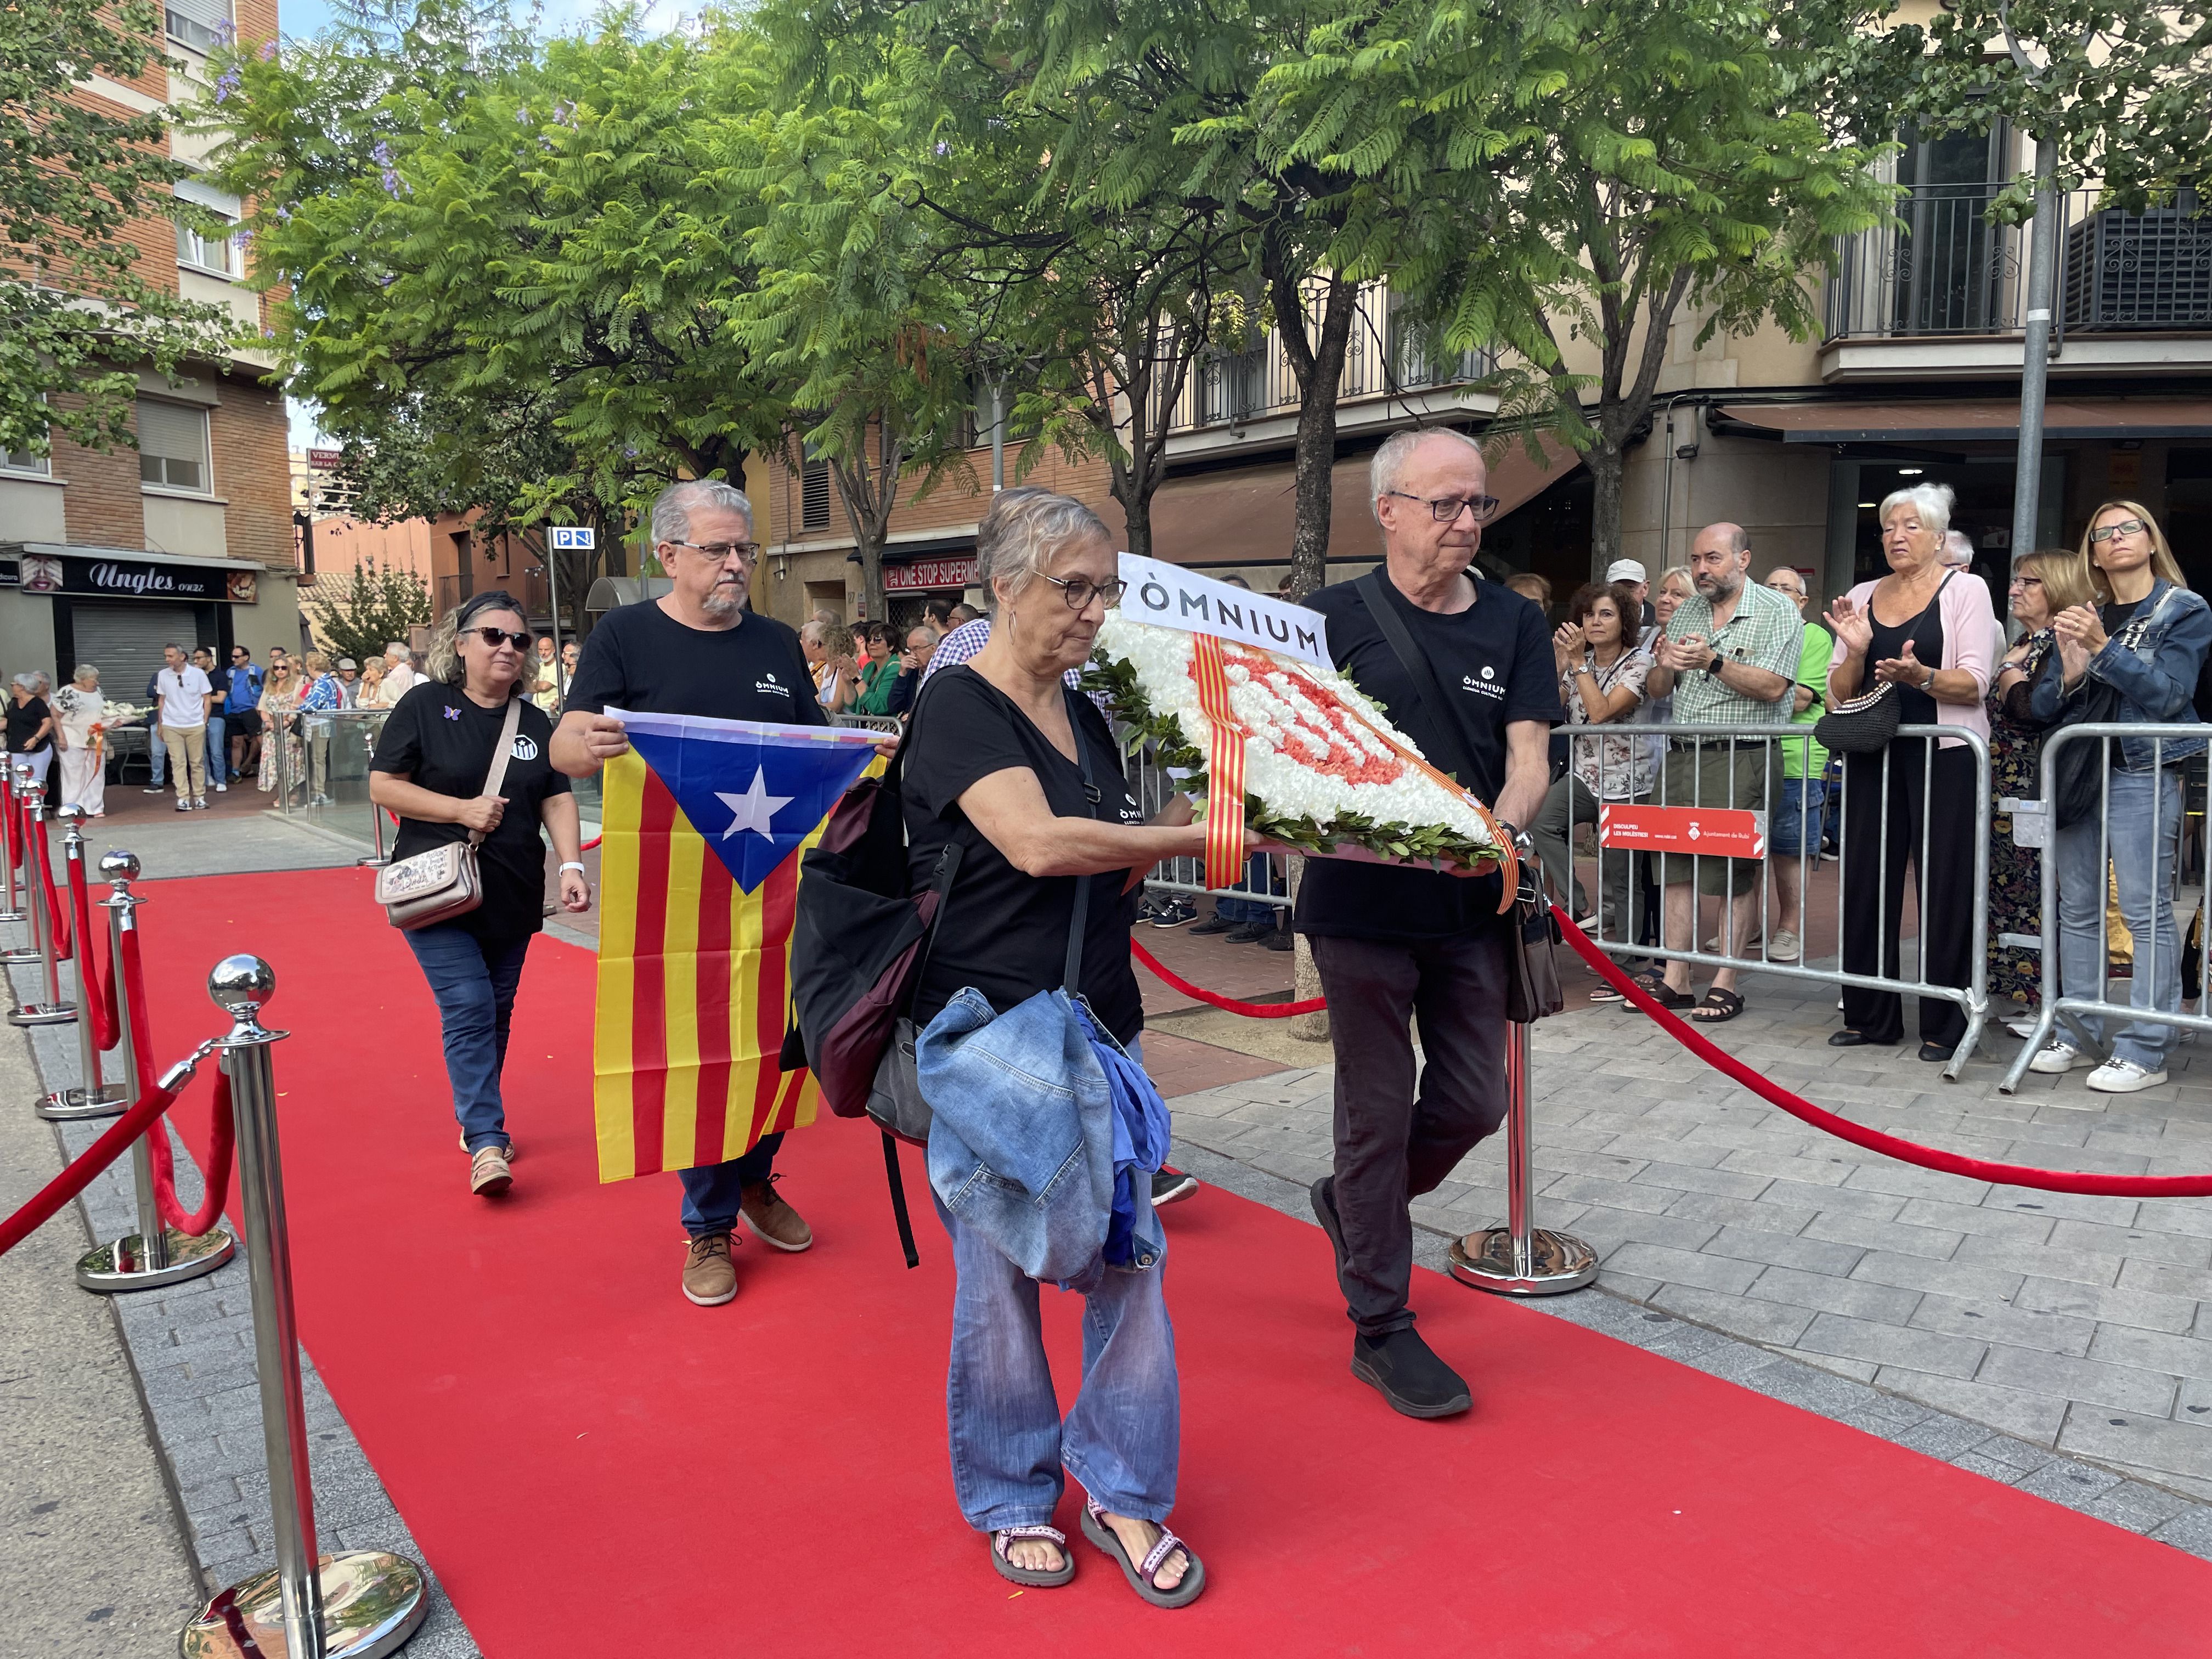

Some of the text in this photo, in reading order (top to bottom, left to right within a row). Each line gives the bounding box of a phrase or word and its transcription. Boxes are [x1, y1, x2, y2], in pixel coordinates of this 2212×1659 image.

[312, 451, 341, 460] VERMU
[560, 532, 570, 545] P
[89, 562, 176, 594] Ungles
[900, 565, 916, 586] ONE
[917, 563, 938, 585] STOP
[939, 560, 980, 583] SUPERME
[1141, 572, 1319, 657] ÒMNIUM
[755, 681, 789, 694] ÒMNIUM
[1463, 675, 1506, 695] ÒMNIUM
[1119, 809, 1142, 819] ÒMN
